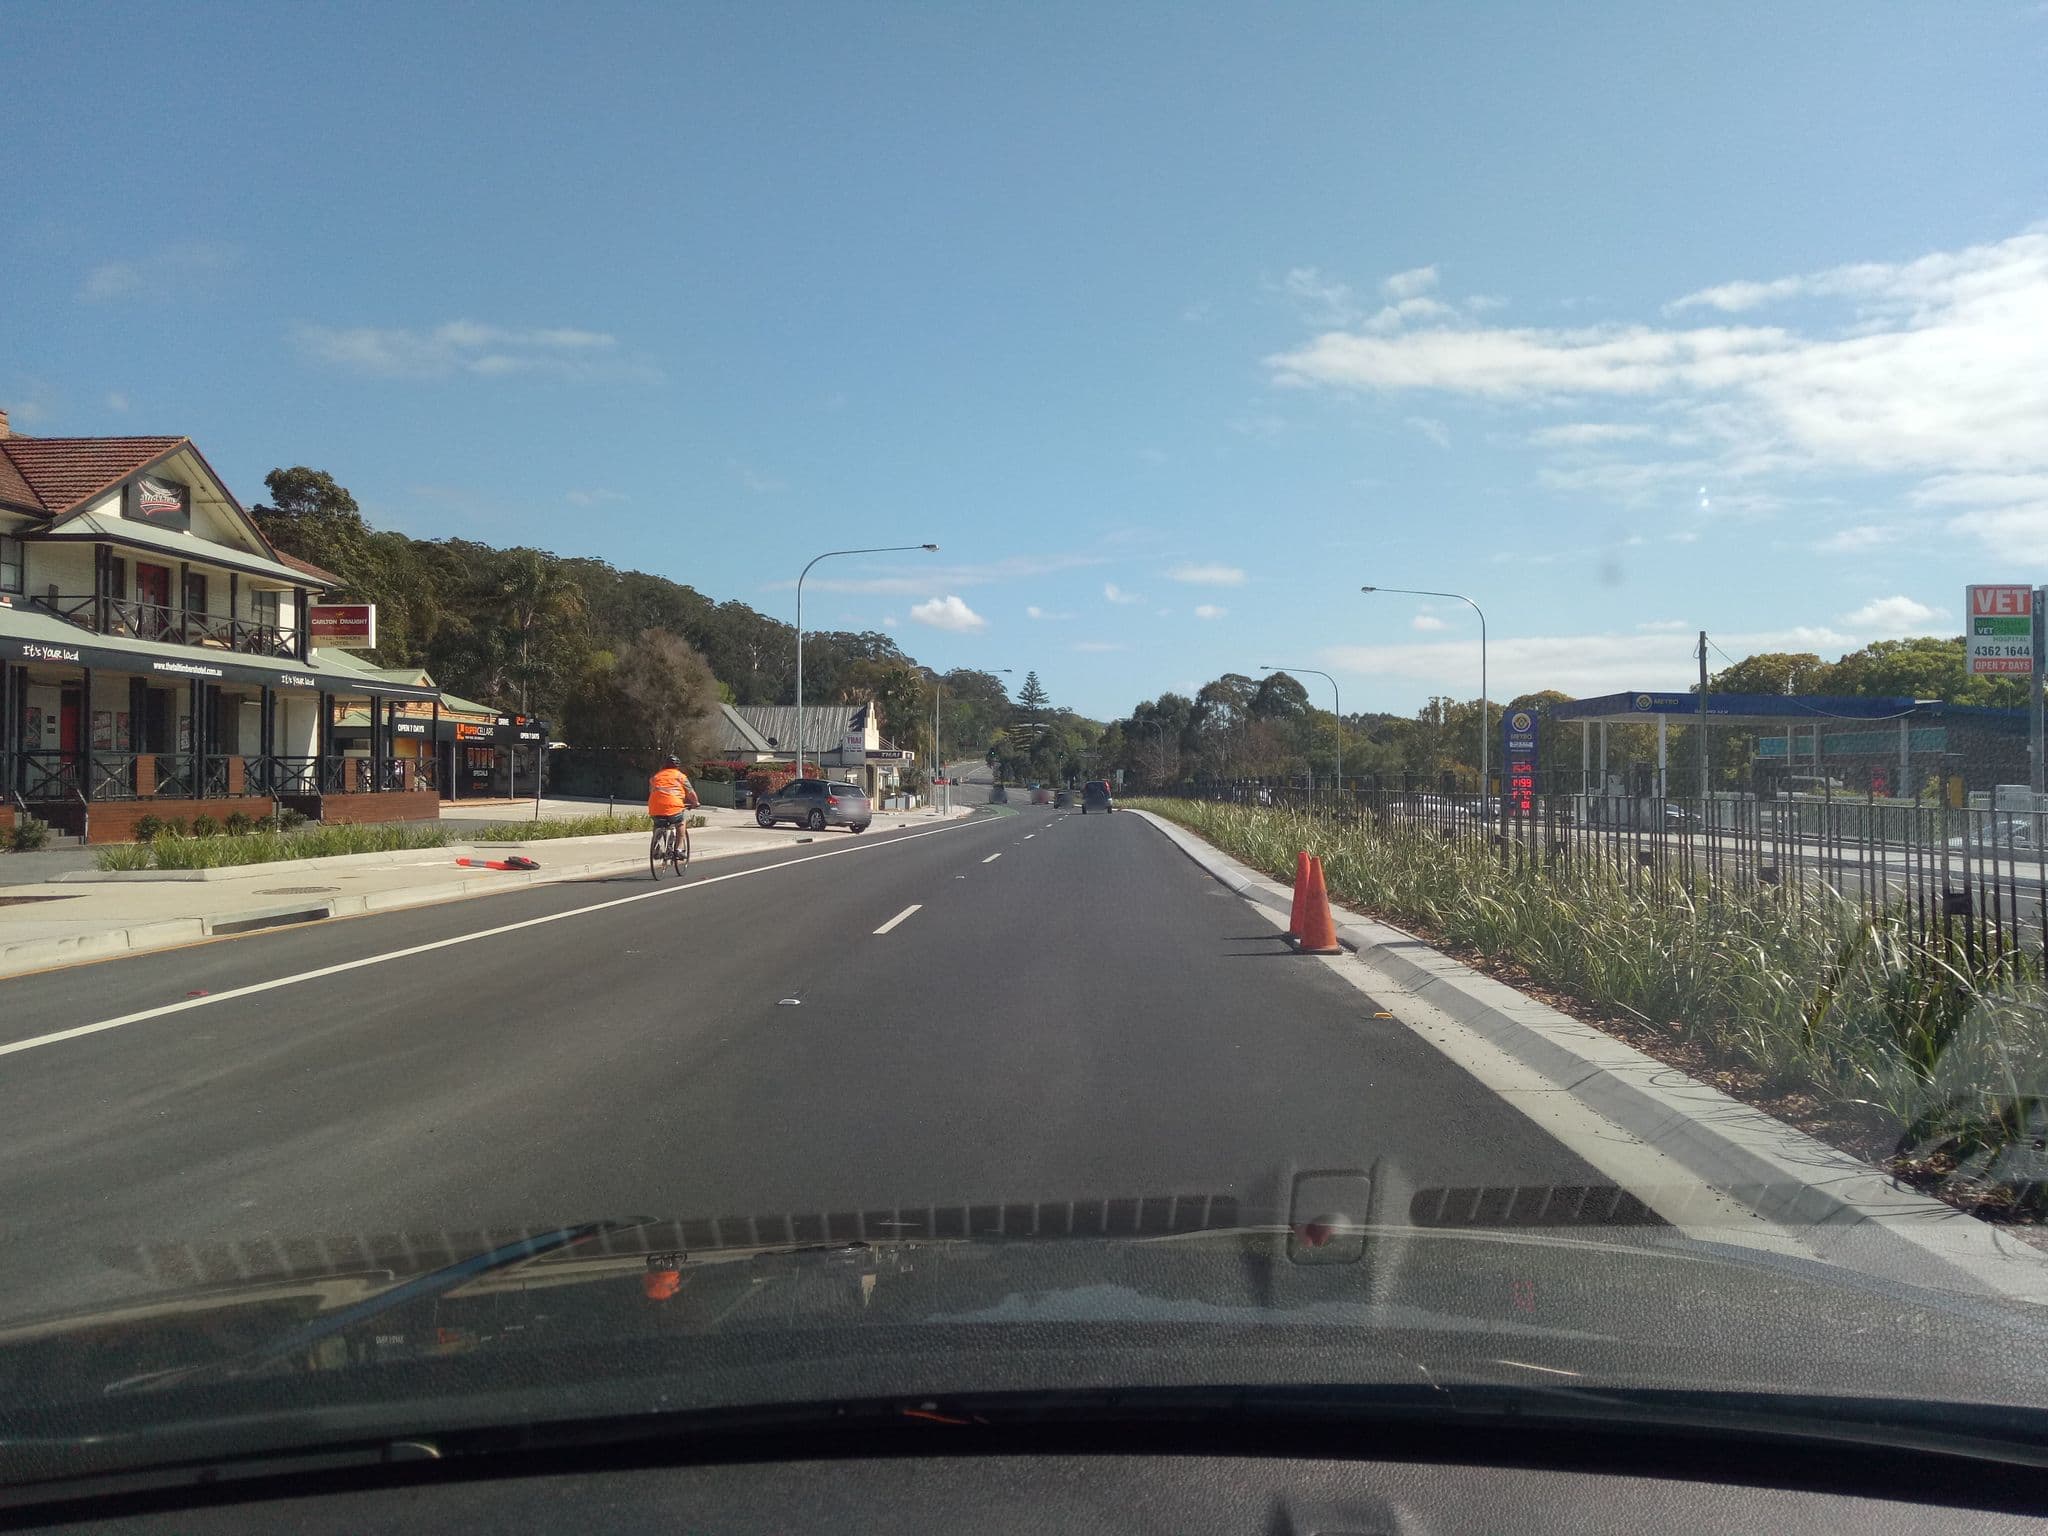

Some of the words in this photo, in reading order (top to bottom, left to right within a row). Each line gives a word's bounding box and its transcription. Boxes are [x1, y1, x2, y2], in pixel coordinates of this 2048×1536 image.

[1976, 589, 2030, 613] VET
[23, 644, 41, 657] It's
[1975, 646, 2001, 656] 4362
[2005, 646, 2030, 656] 1644
[1975, 661, 1998, 670] OPEN
[2000, 661, 2007, 670] 7
[2008, 661, 2030, 670] DAYS
[397, 723, 410, 732] OPEN
[413, 724, 425, 733] DAYS
